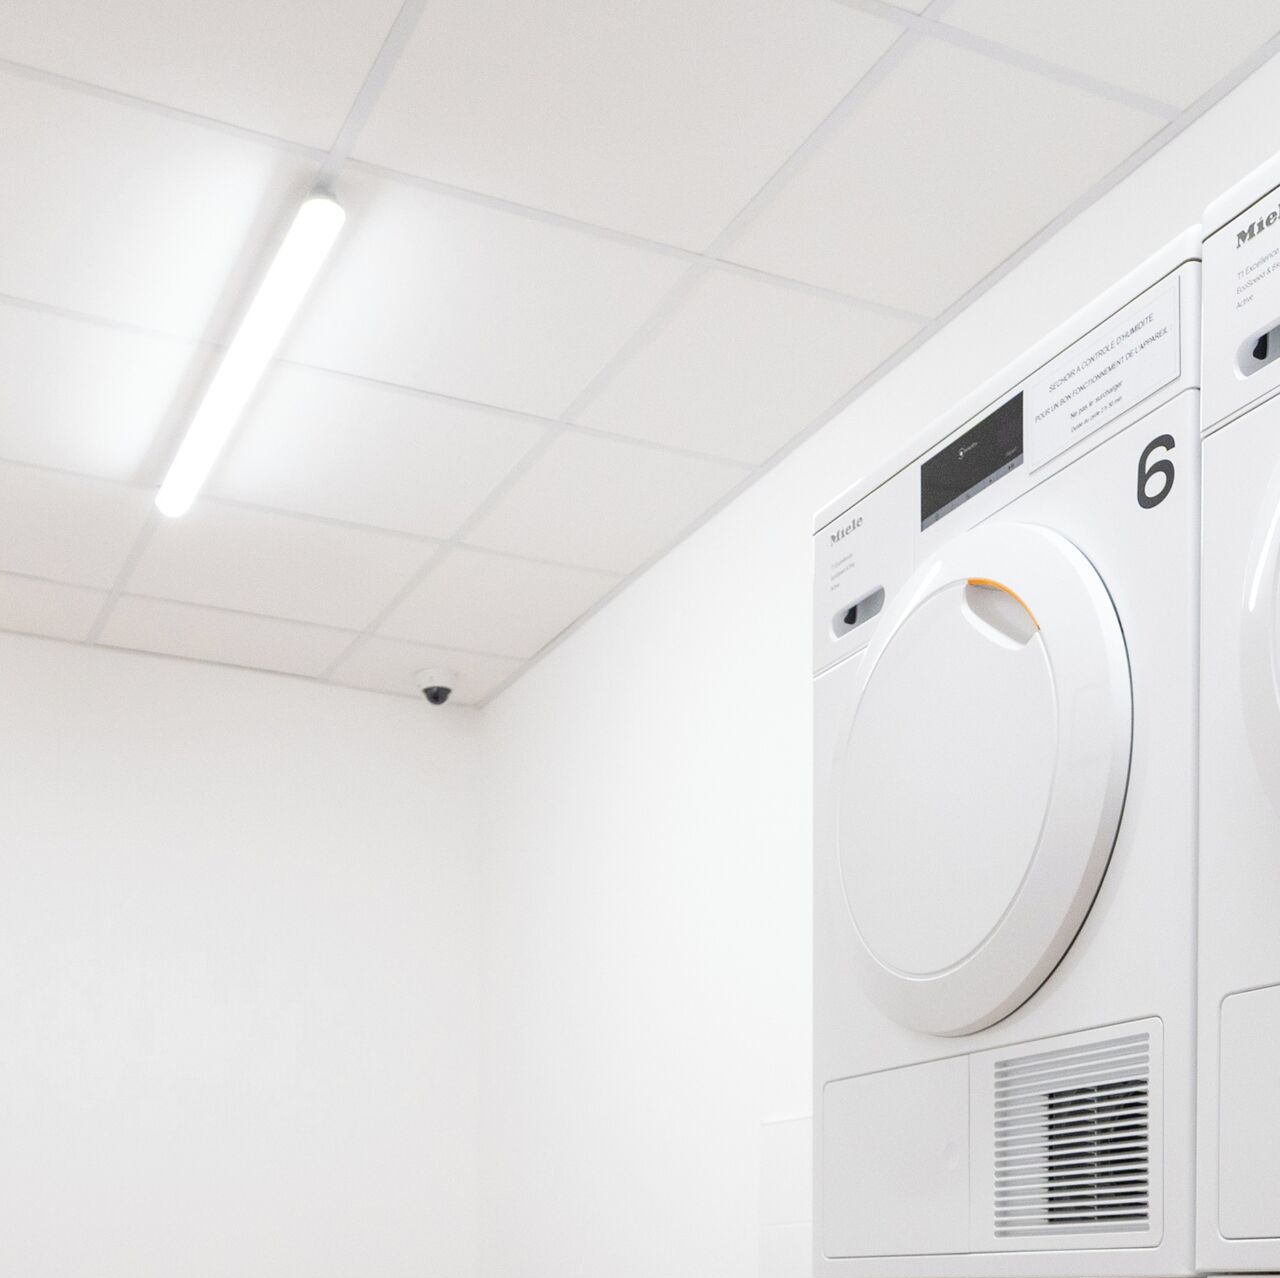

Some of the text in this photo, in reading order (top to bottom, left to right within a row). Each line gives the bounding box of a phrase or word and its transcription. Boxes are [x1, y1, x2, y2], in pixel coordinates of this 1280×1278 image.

[1245, 248, 1279, 276] Excellence
[1137, 433, 1176, 509] 6
[830, 517, 863, 547] Miele
